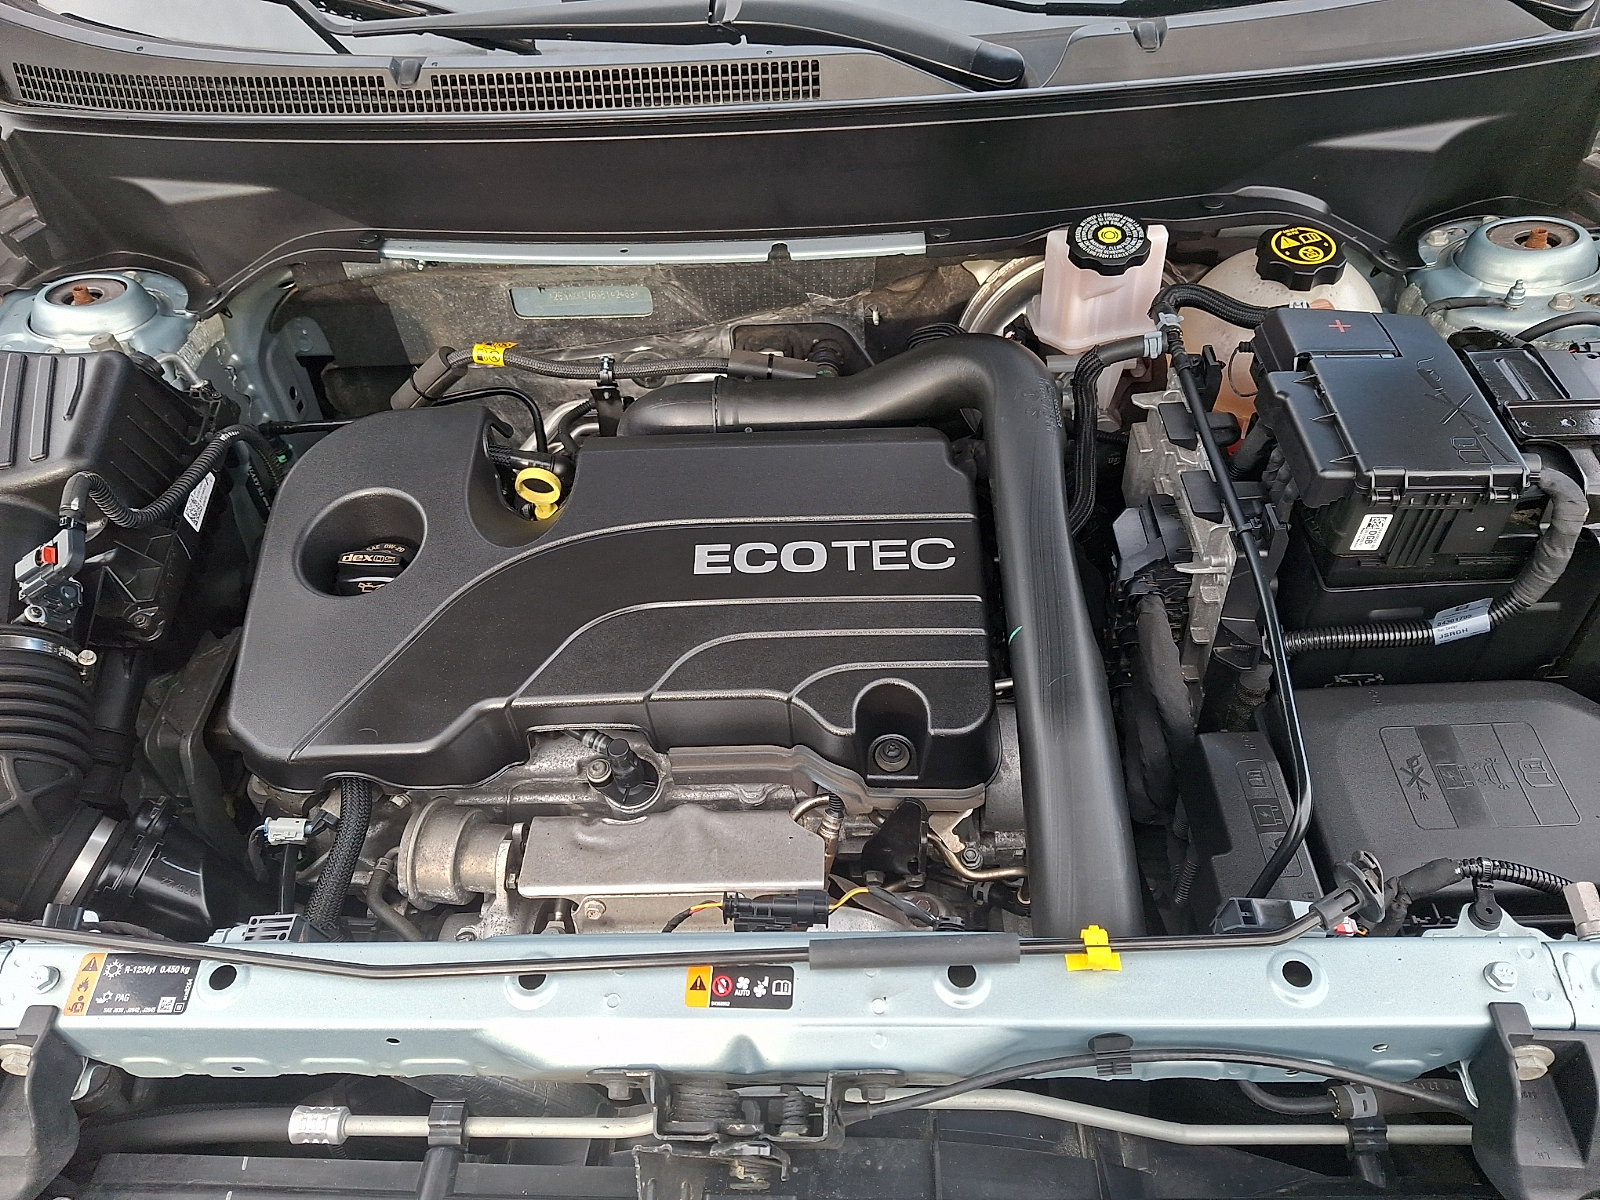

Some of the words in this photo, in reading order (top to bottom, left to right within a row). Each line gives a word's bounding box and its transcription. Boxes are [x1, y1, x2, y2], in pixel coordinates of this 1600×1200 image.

[383, 543, 406, 553] 0W-20
[341, 553, 397, 563] dexos
[693, 537, 957, 575] ECOTEC
[124, 965, 157, 975] R-1234yf
[159, 965, 180, 974] 0.450
[180, 965, 191, 975] kg
[114, 993, 131, 1002] PAG
[734, 989, 751, 997] AUTO
